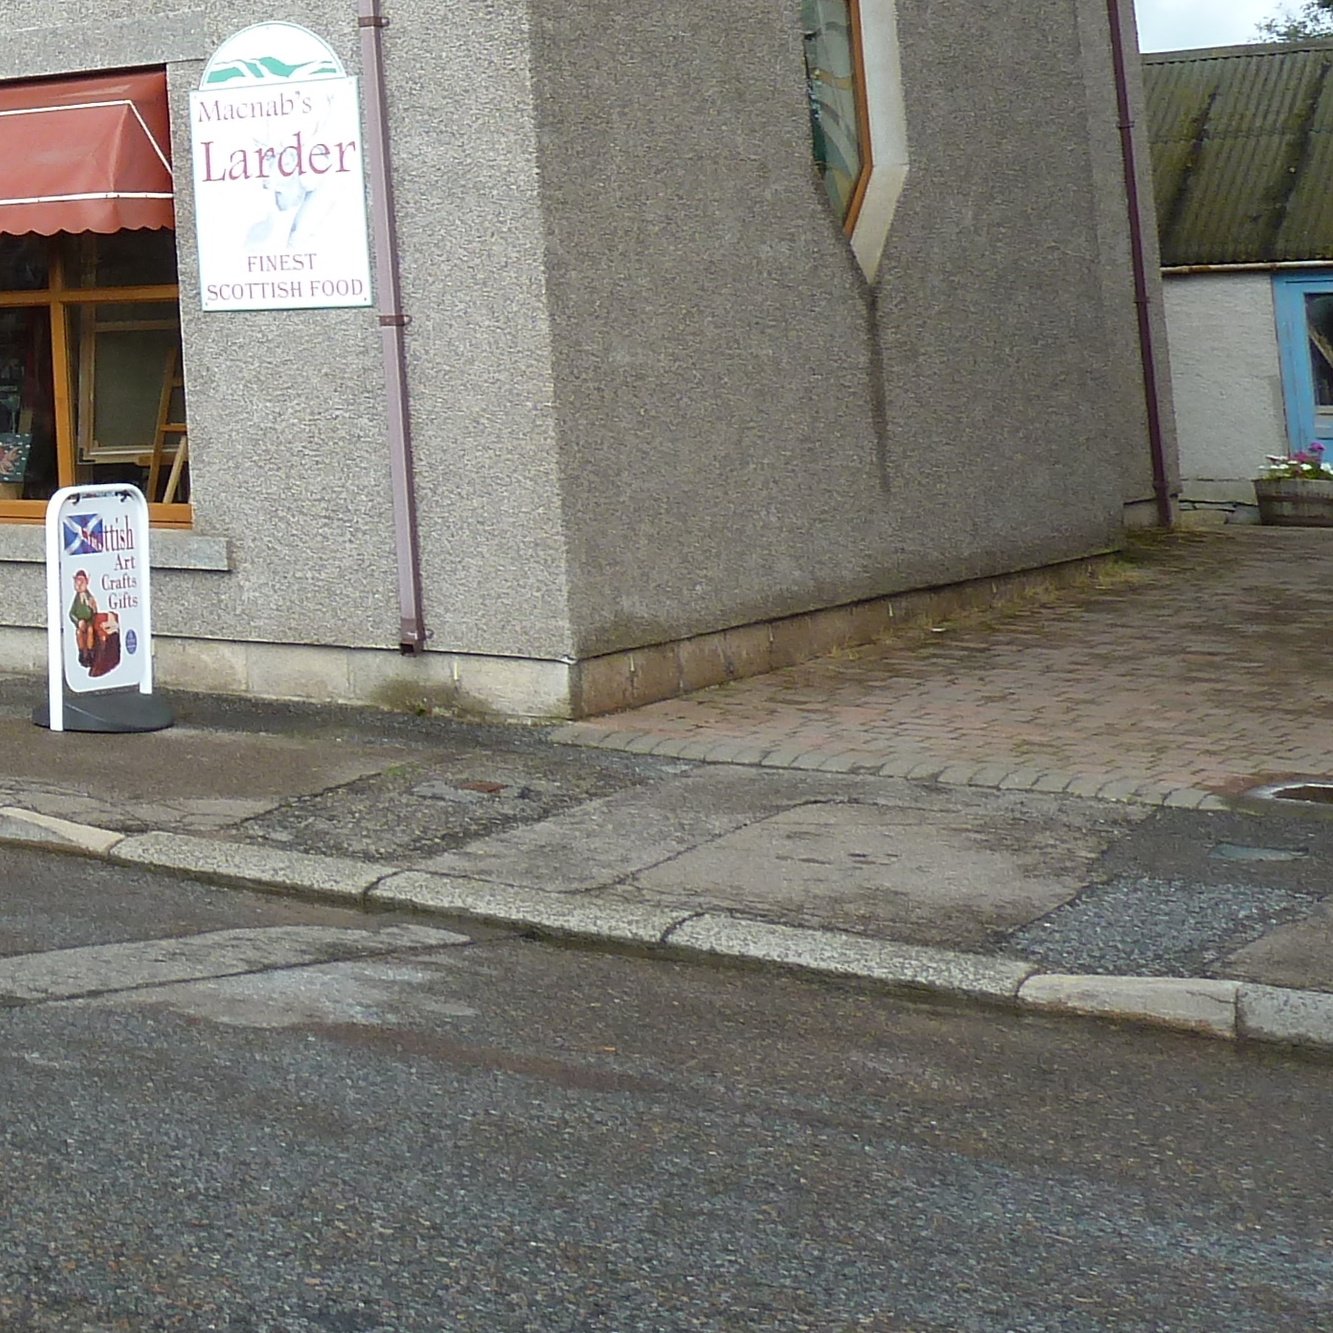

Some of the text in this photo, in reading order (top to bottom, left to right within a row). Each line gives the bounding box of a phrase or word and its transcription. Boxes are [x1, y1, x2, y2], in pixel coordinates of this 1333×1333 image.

[198, 90, 313, 122] Macnab's
[200, 130, 356, 183] Larder
[247, 253, 318, 273] FINEST
[207, 278, 364, 302] SCOTTISH FOOD
[80, 514, 135, 553] Scottish
[114, 554, 136, 571] Art
[101, 572, 137, 591] Crafts
[108, 591, 139, 610] Gifts
